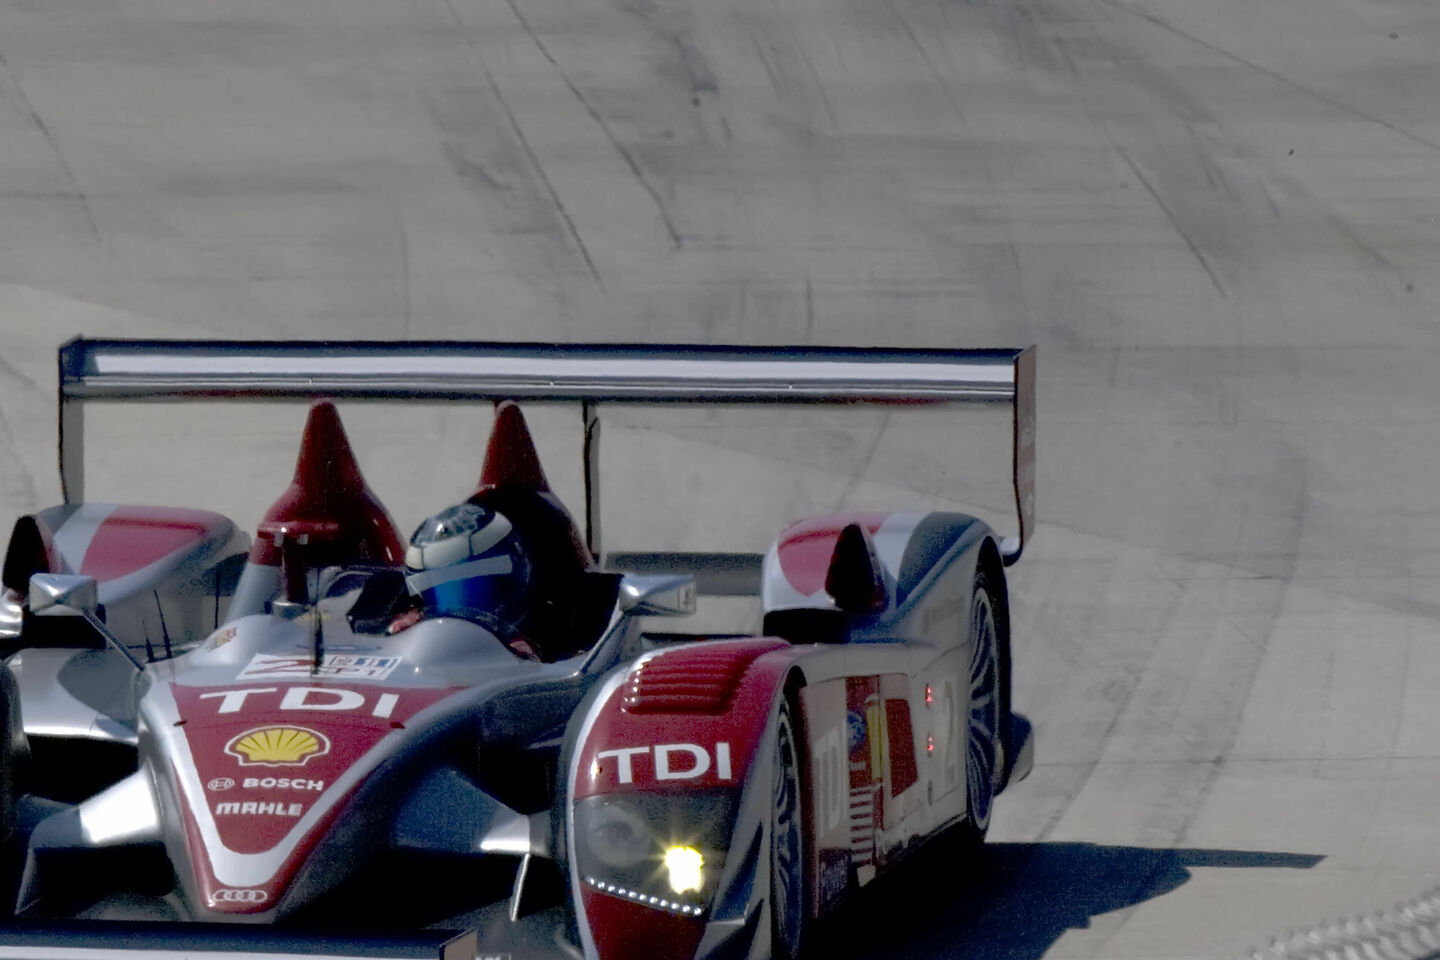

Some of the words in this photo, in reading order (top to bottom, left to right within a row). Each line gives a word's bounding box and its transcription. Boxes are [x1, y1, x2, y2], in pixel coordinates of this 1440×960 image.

[245, 659, 318, 675] 2
[200, 687, 399, 718] TDI
[598, 742, 732, 784] TDI
[242, 777, 324, 791] BOSCH
[216, 801, 303, 816] MAHLE
